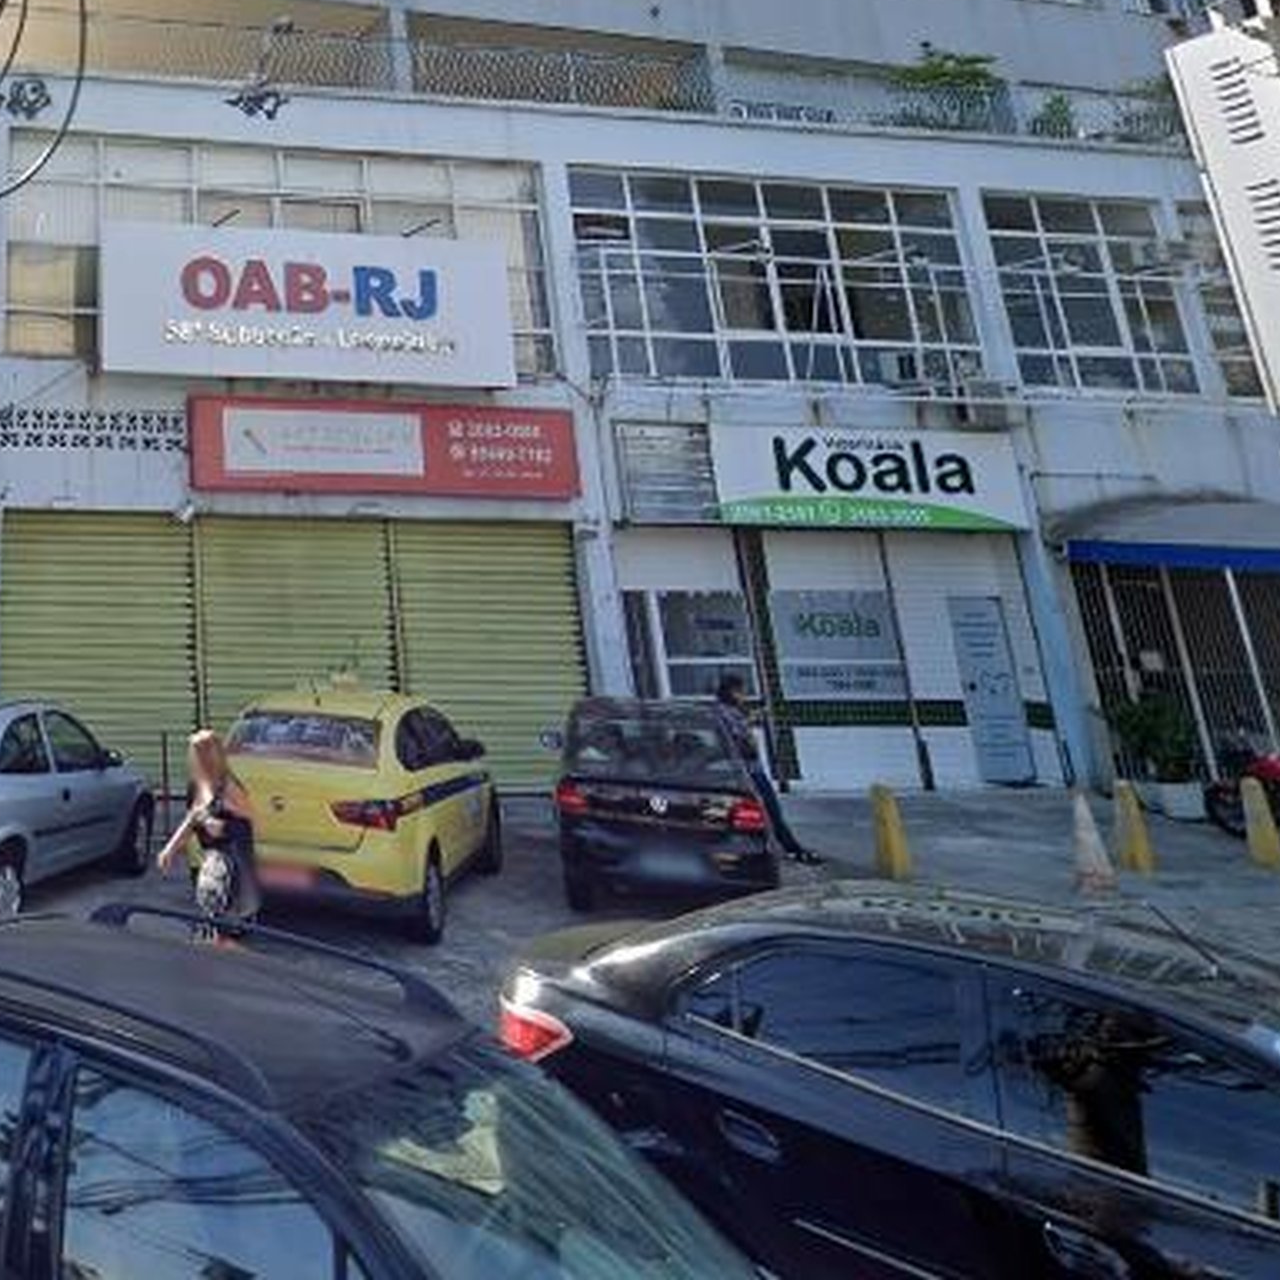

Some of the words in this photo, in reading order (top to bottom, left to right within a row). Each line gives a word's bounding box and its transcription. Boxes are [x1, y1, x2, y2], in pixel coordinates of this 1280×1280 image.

[180, 255, 438, 320] OAB-RJ
[772, 436, 976, 495] Koala
[797, 610, 882, 639] Koala
